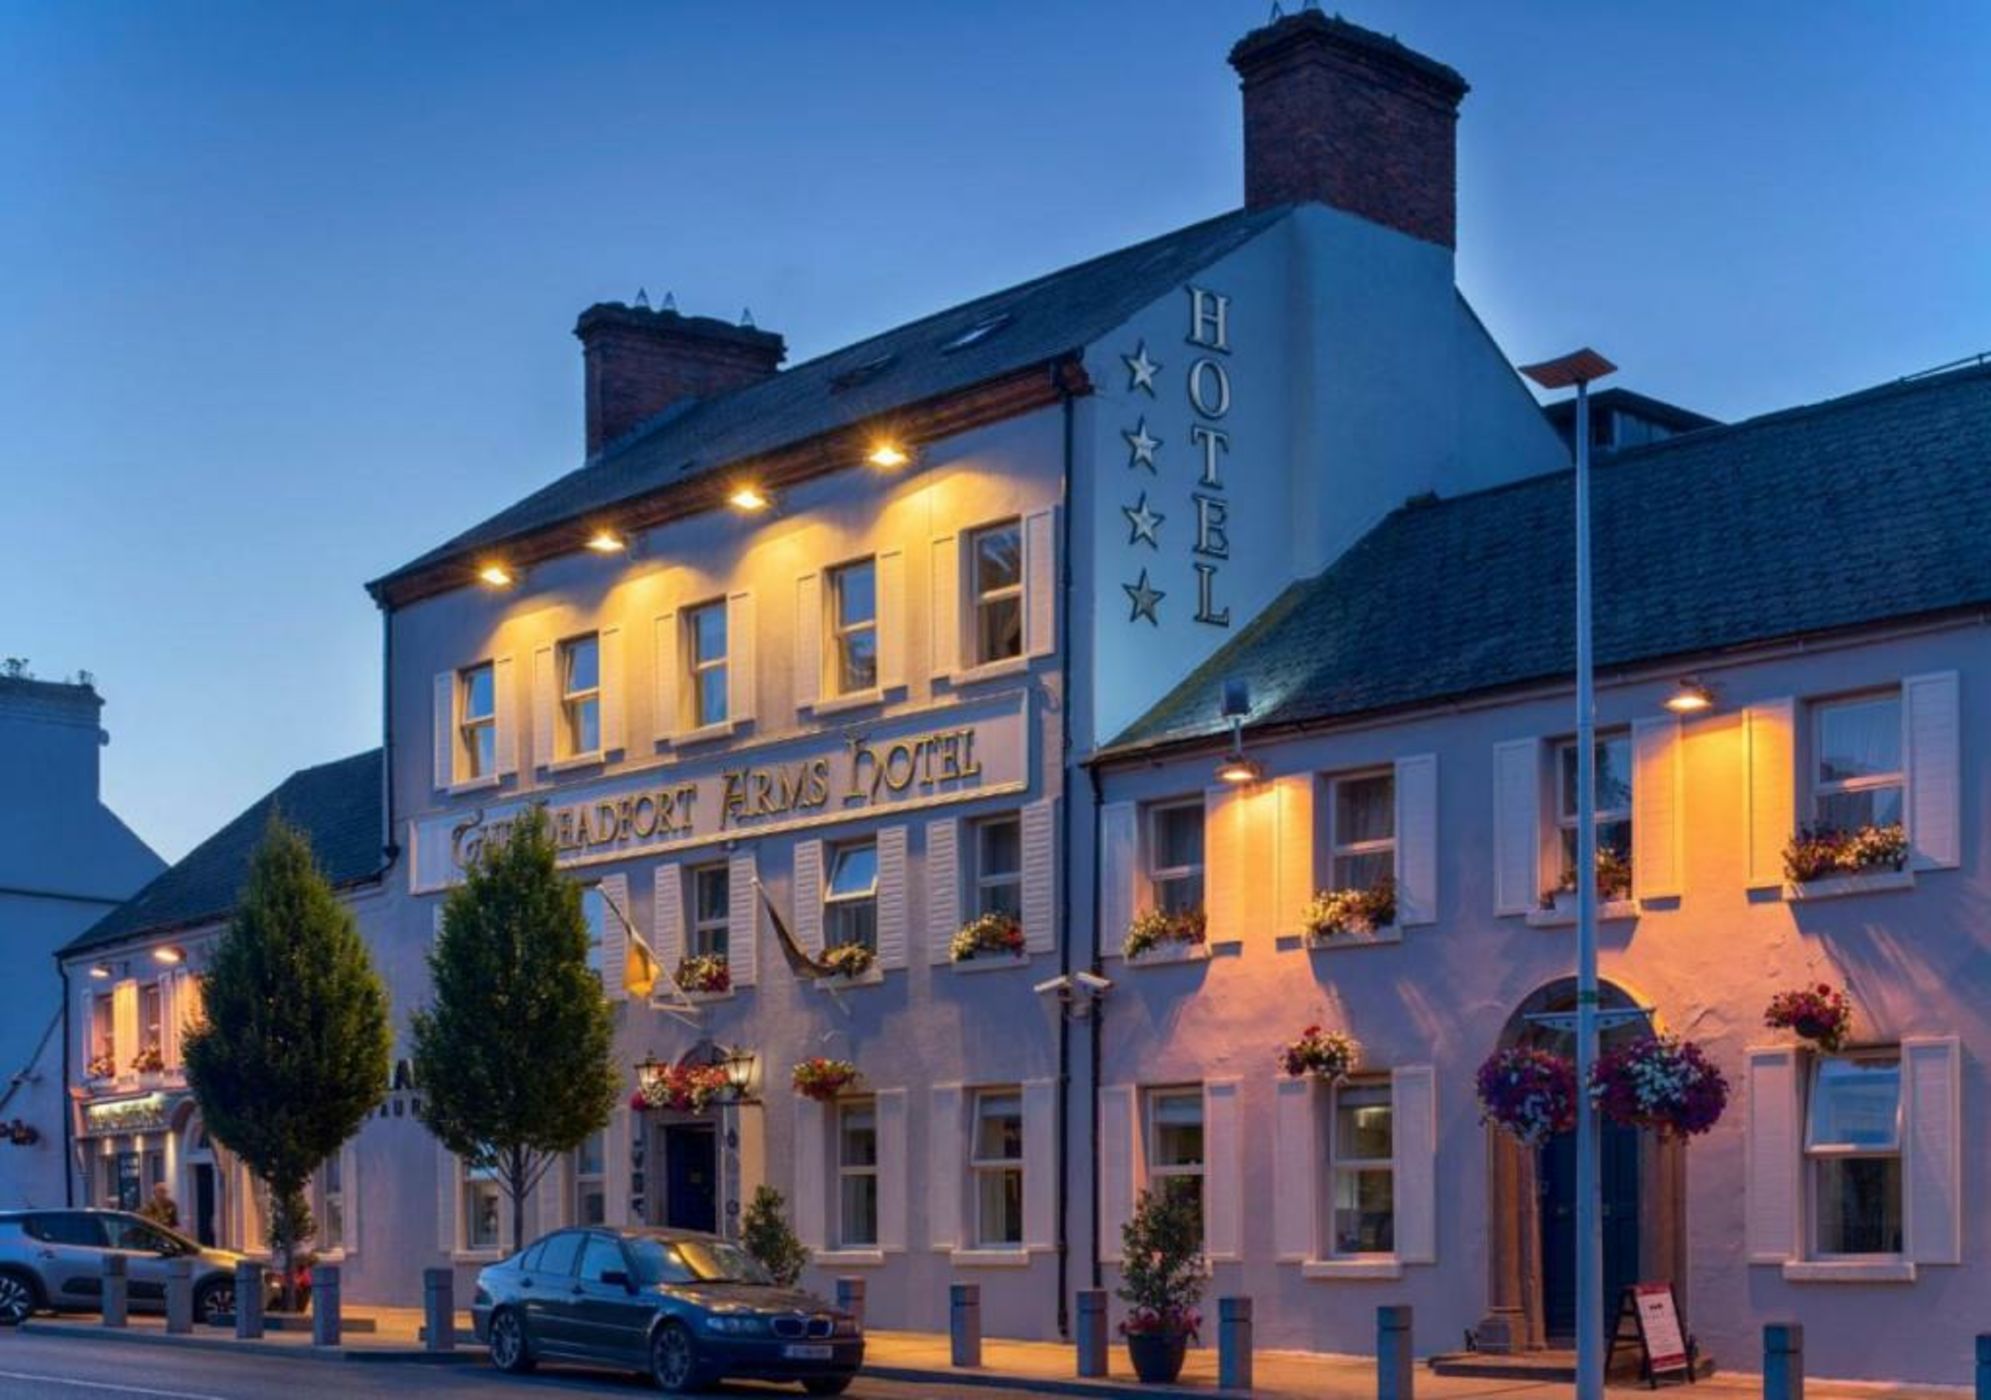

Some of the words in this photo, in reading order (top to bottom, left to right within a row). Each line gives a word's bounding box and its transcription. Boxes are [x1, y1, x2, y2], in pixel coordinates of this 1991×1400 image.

[1185, 285, 1232, 628] HOTEL
[720, 758, 829, 829] ARMS
[843, 729, 981, 806] HOTEL
